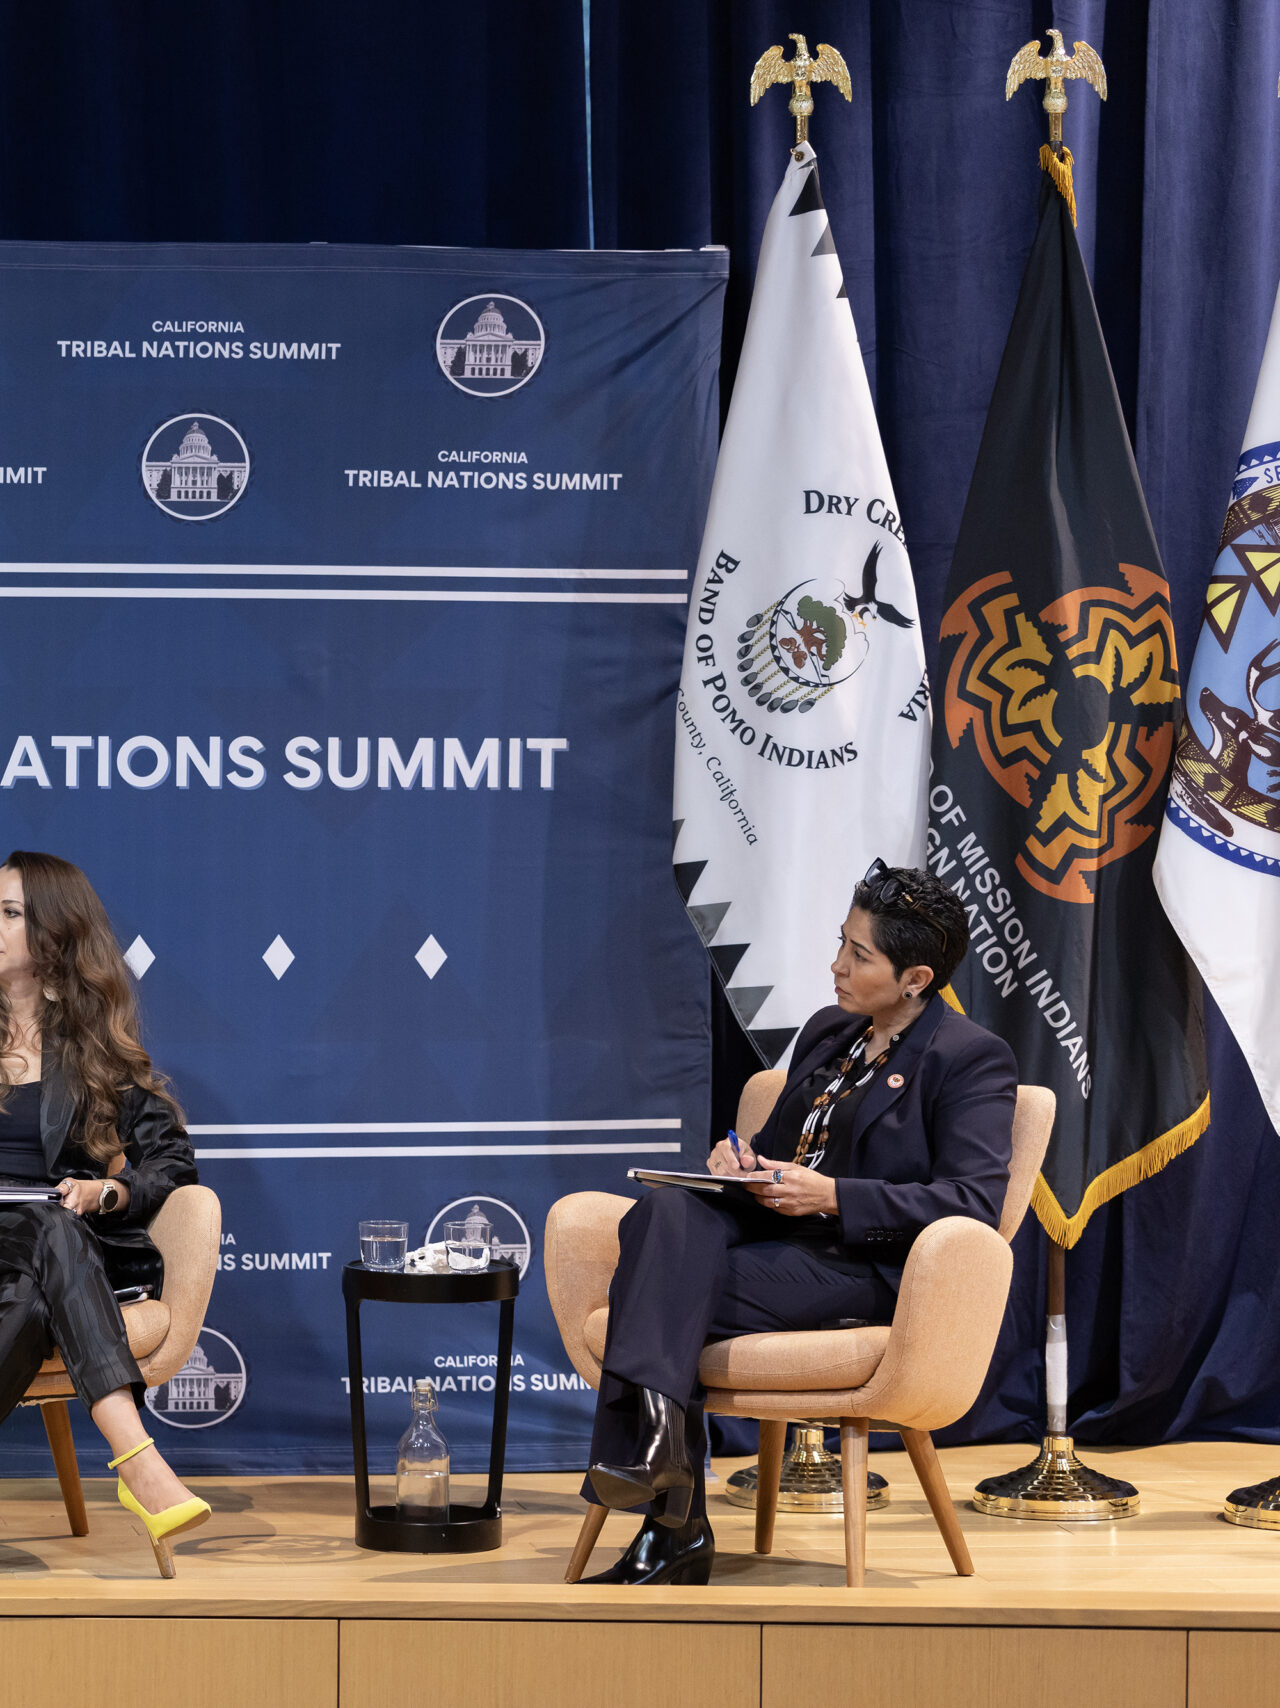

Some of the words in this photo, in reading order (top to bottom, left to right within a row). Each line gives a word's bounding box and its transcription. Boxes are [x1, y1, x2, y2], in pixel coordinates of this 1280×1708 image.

[151, 320, 245, 333] CALIFORNIA
[56, 340, 137, 358] TRIBAL
[142, 341, 244, 359] NATIONS
[249, 341, 342, 360] SUMMIT
[437, 450, 529, 464] CALIFORNIA
[344, 469, 422, 488] TRIBAL
[427, 470, 528, 490] NATIONS
[532, 472, 623, 491] SUMMIT
[803, 490, 860, 516] DRY
[866, 498, 907, 549] CRE
[698, 549, 741, 625] BAND
[695, 634, 716, 667] OF
[701, 671, 756, 746] POMO
[282, 735, 569, 791] SUMMIT
[758, 733, 858, 769] INDIANS
[706, 756, 758, 846] California
[930, 785, 967, 827] OF
[957, 832, 1038, 970] MISSION
[1025, 969, 1092, 1100] INDIANS
[241, 1252, 332, 1271] SUMMIT
[433, 1353, 525, 1368] CALIFORIA
[424, 1374, 526, 1393] NATIOS
